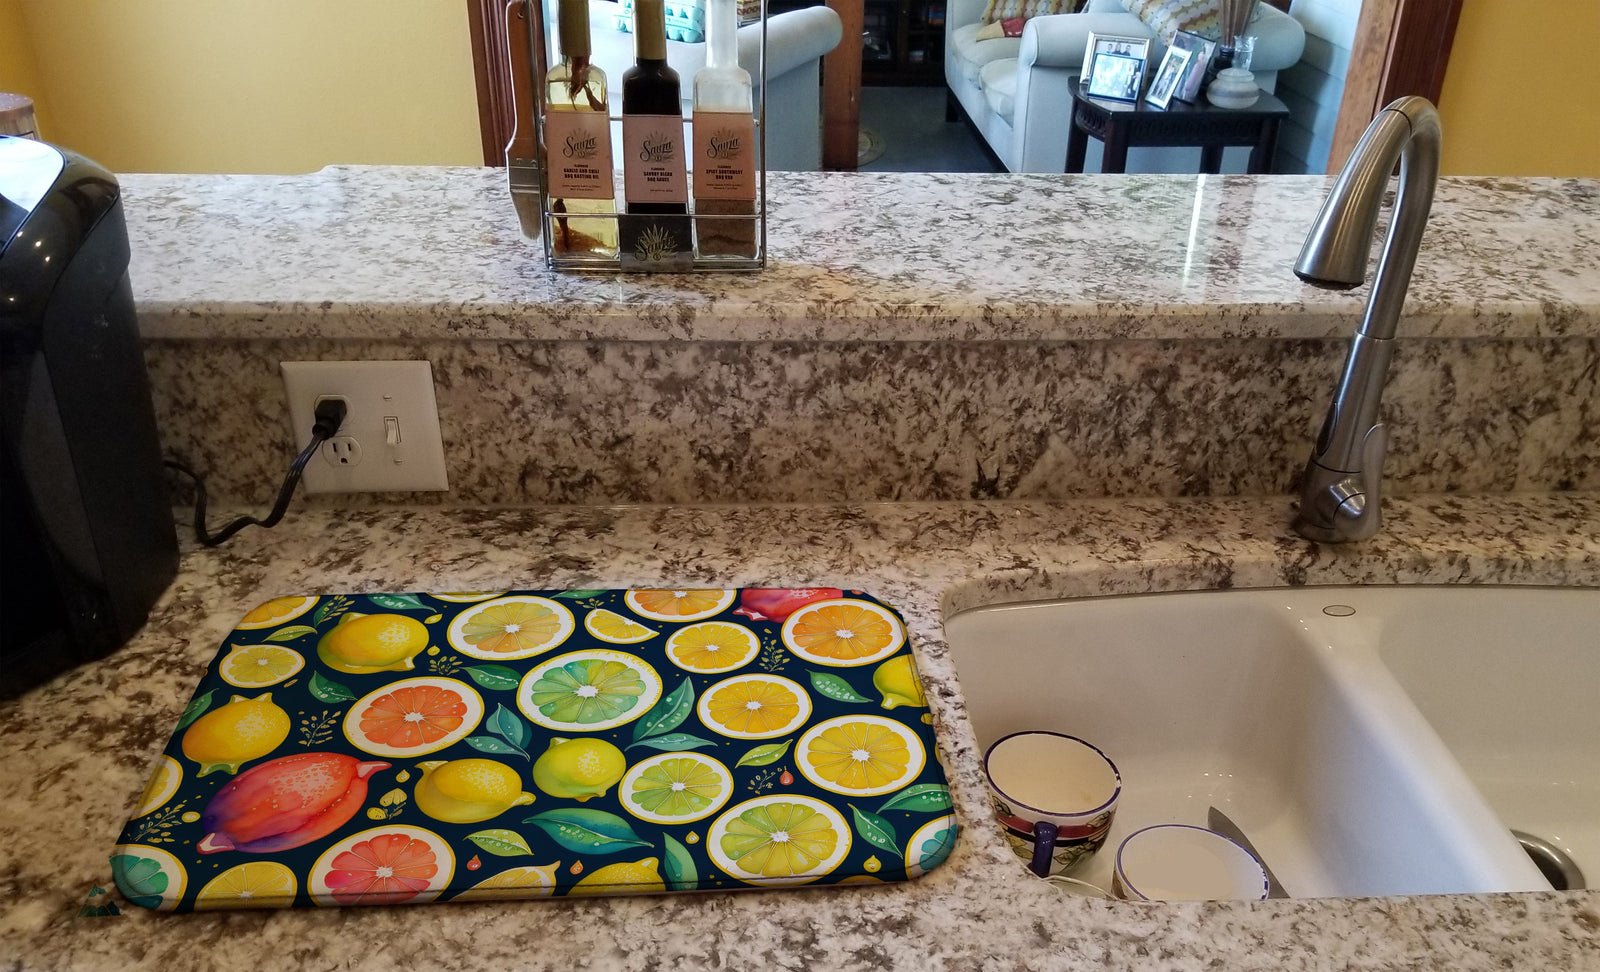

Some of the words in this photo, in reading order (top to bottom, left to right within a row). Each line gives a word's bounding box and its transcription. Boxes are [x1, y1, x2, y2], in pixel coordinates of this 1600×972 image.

[563, 135, 598, 158] Sauza
[640, 140, 674, 162] Sauza
[706, 136, 741, 159] Sauza
